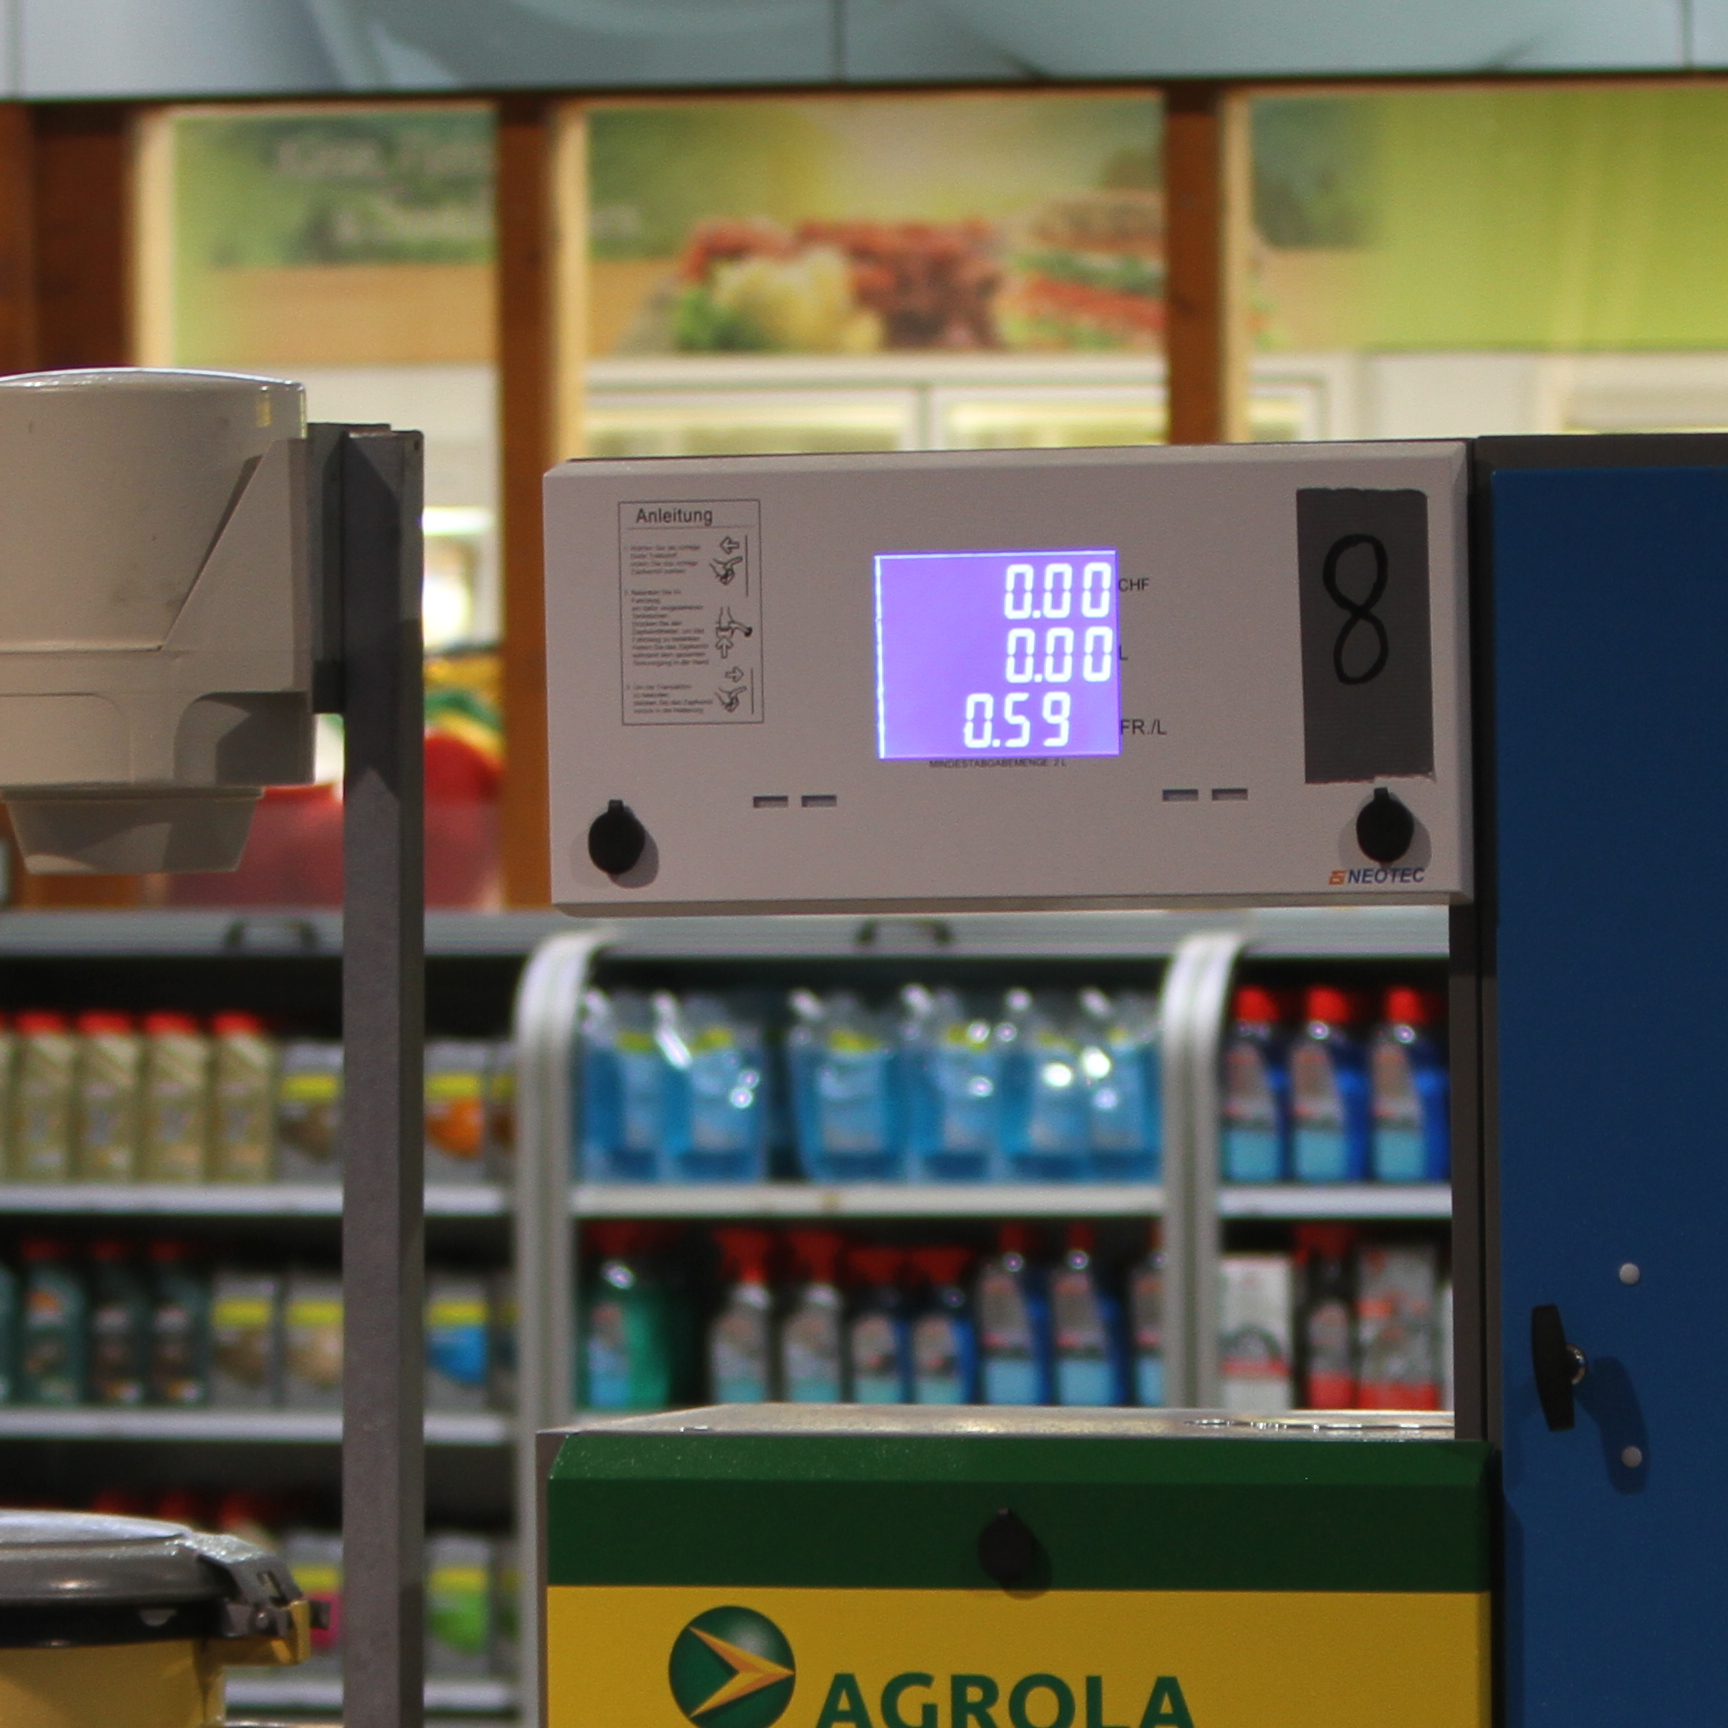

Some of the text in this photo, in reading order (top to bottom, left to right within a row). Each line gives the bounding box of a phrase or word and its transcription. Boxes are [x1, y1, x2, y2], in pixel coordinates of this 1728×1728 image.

[636, 508, 713, 526] Anleitung
[1004, 562, 1112, 620] 0.00
[1118, 577, 1150, 593] CHF
[1323, 533, 1389, 686] 8
[1006, 626, 1114, 684] 0.00
[963, 691, 1072, 749] 0.59
[1120, 719, 1168, 736] FR./L
[1347, 868, 1425, 885] NEOTEC
